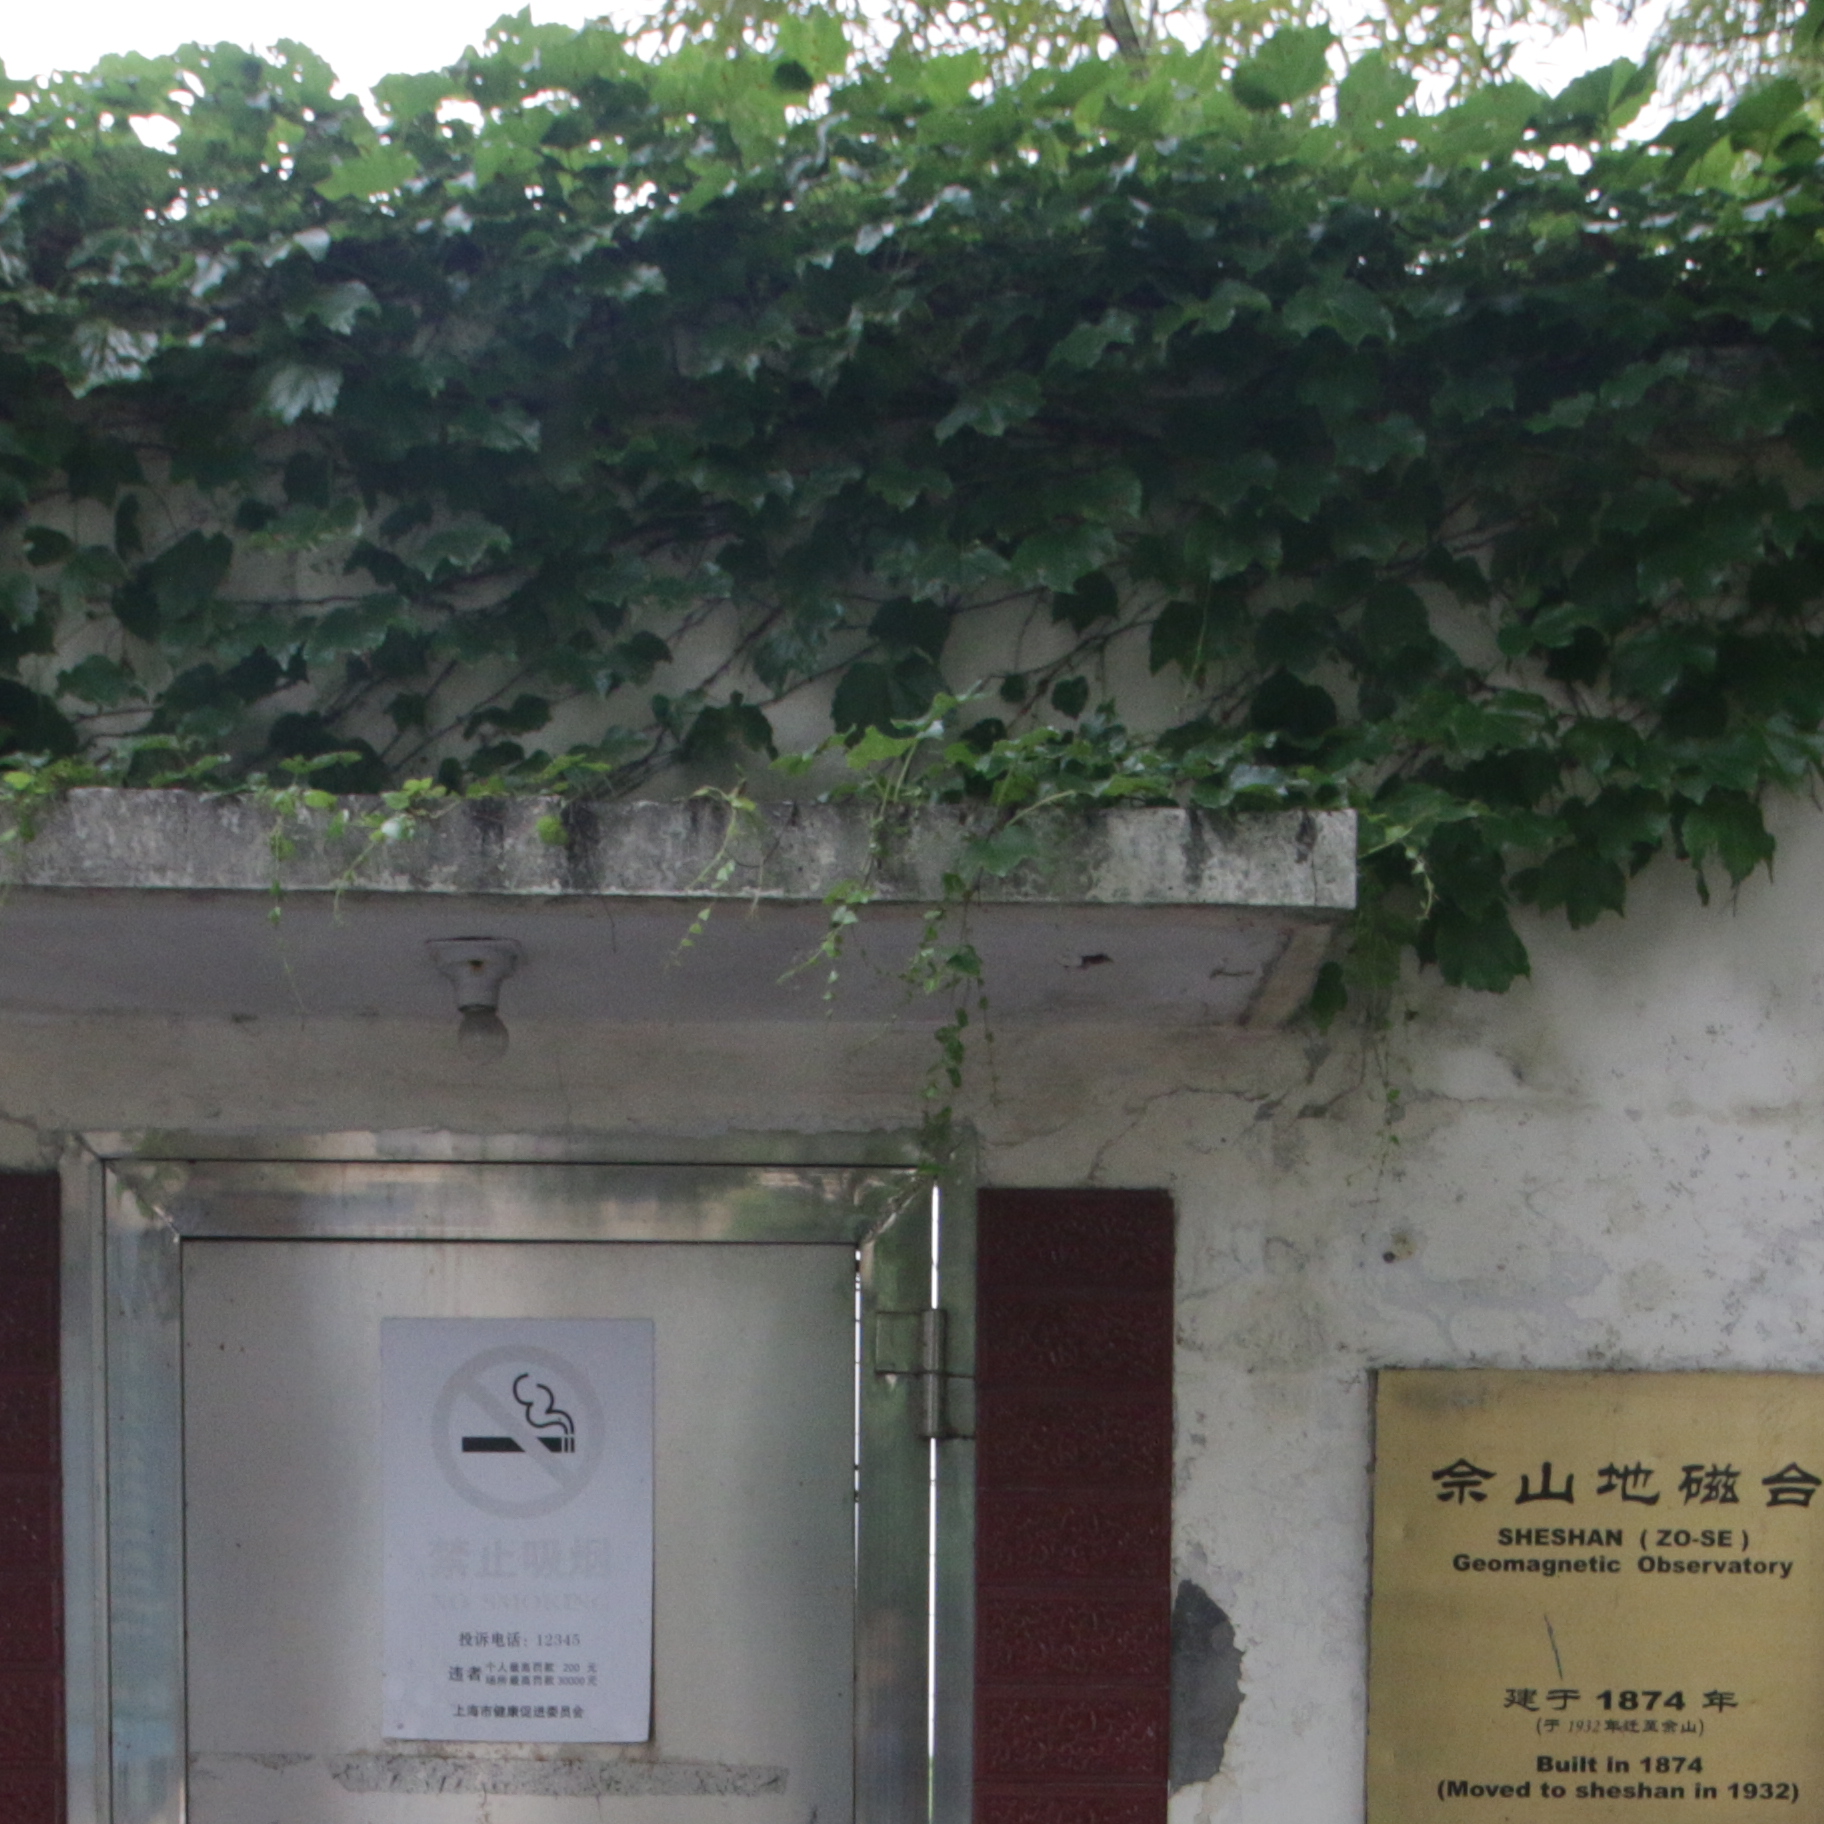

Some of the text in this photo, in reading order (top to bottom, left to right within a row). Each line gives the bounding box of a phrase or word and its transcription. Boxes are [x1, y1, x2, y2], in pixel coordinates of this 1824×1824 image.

[1431, 1458, 1823, 1508] 佘山地磁台
[1497, 1528, 1624, 1548] SHESHAN
[1452, 1554, 1794, 1579] Geomagnetic Observatory
[1536, 1755, 1704, 1774] Built in 1874
[1436, 1780, 1800, 1804] (Moved to sheshan in 1932)
